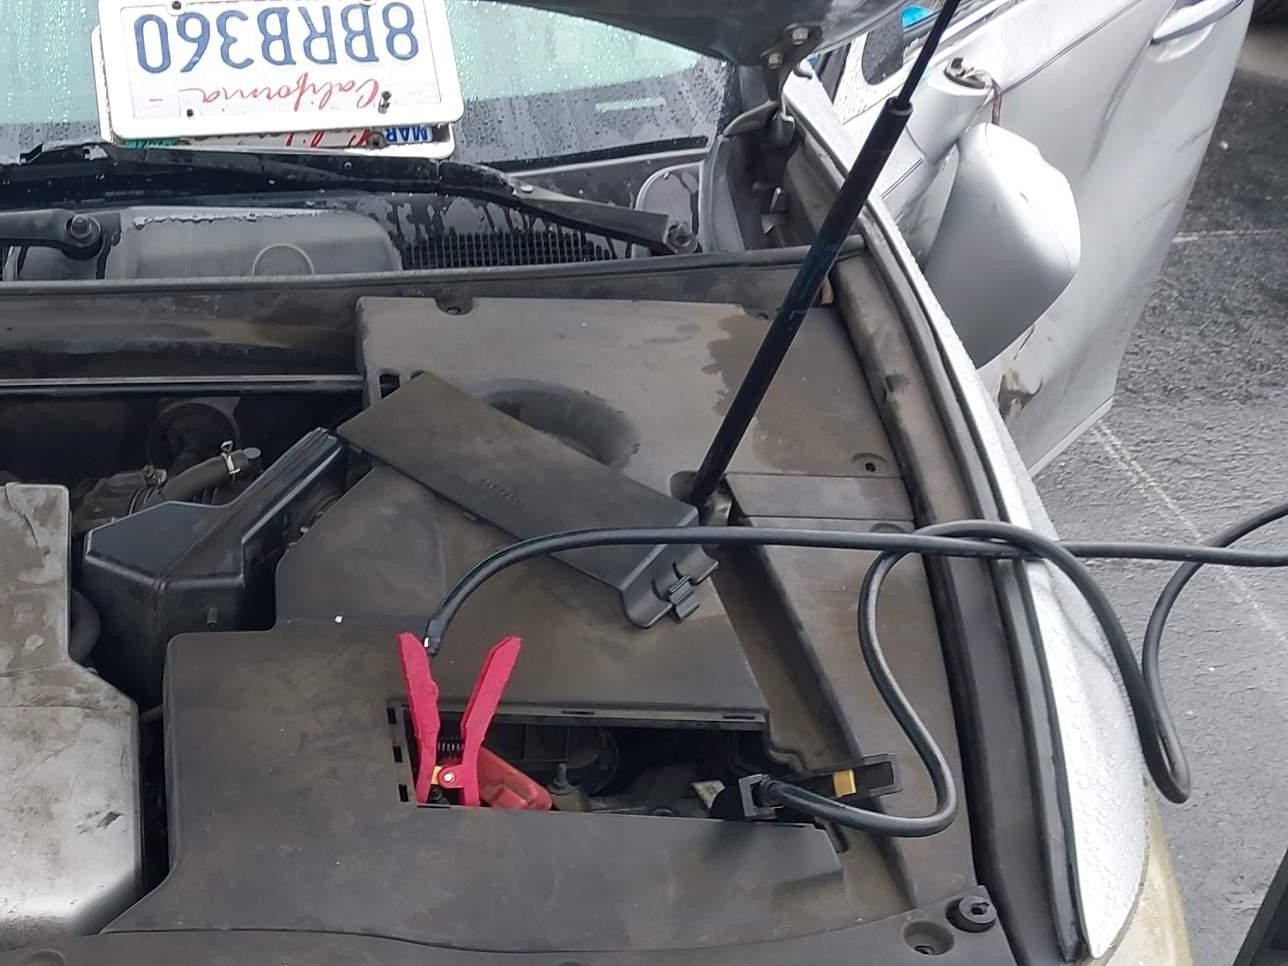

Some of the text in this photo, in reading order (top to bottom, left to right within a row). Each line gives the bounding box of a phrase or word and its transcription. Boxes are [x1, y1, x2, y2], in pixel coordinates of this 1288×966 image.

[133, 2, 420, 74] 8BRB360
[178, 71, 381, 113] California
[384, 127, 429, 143] MAR
